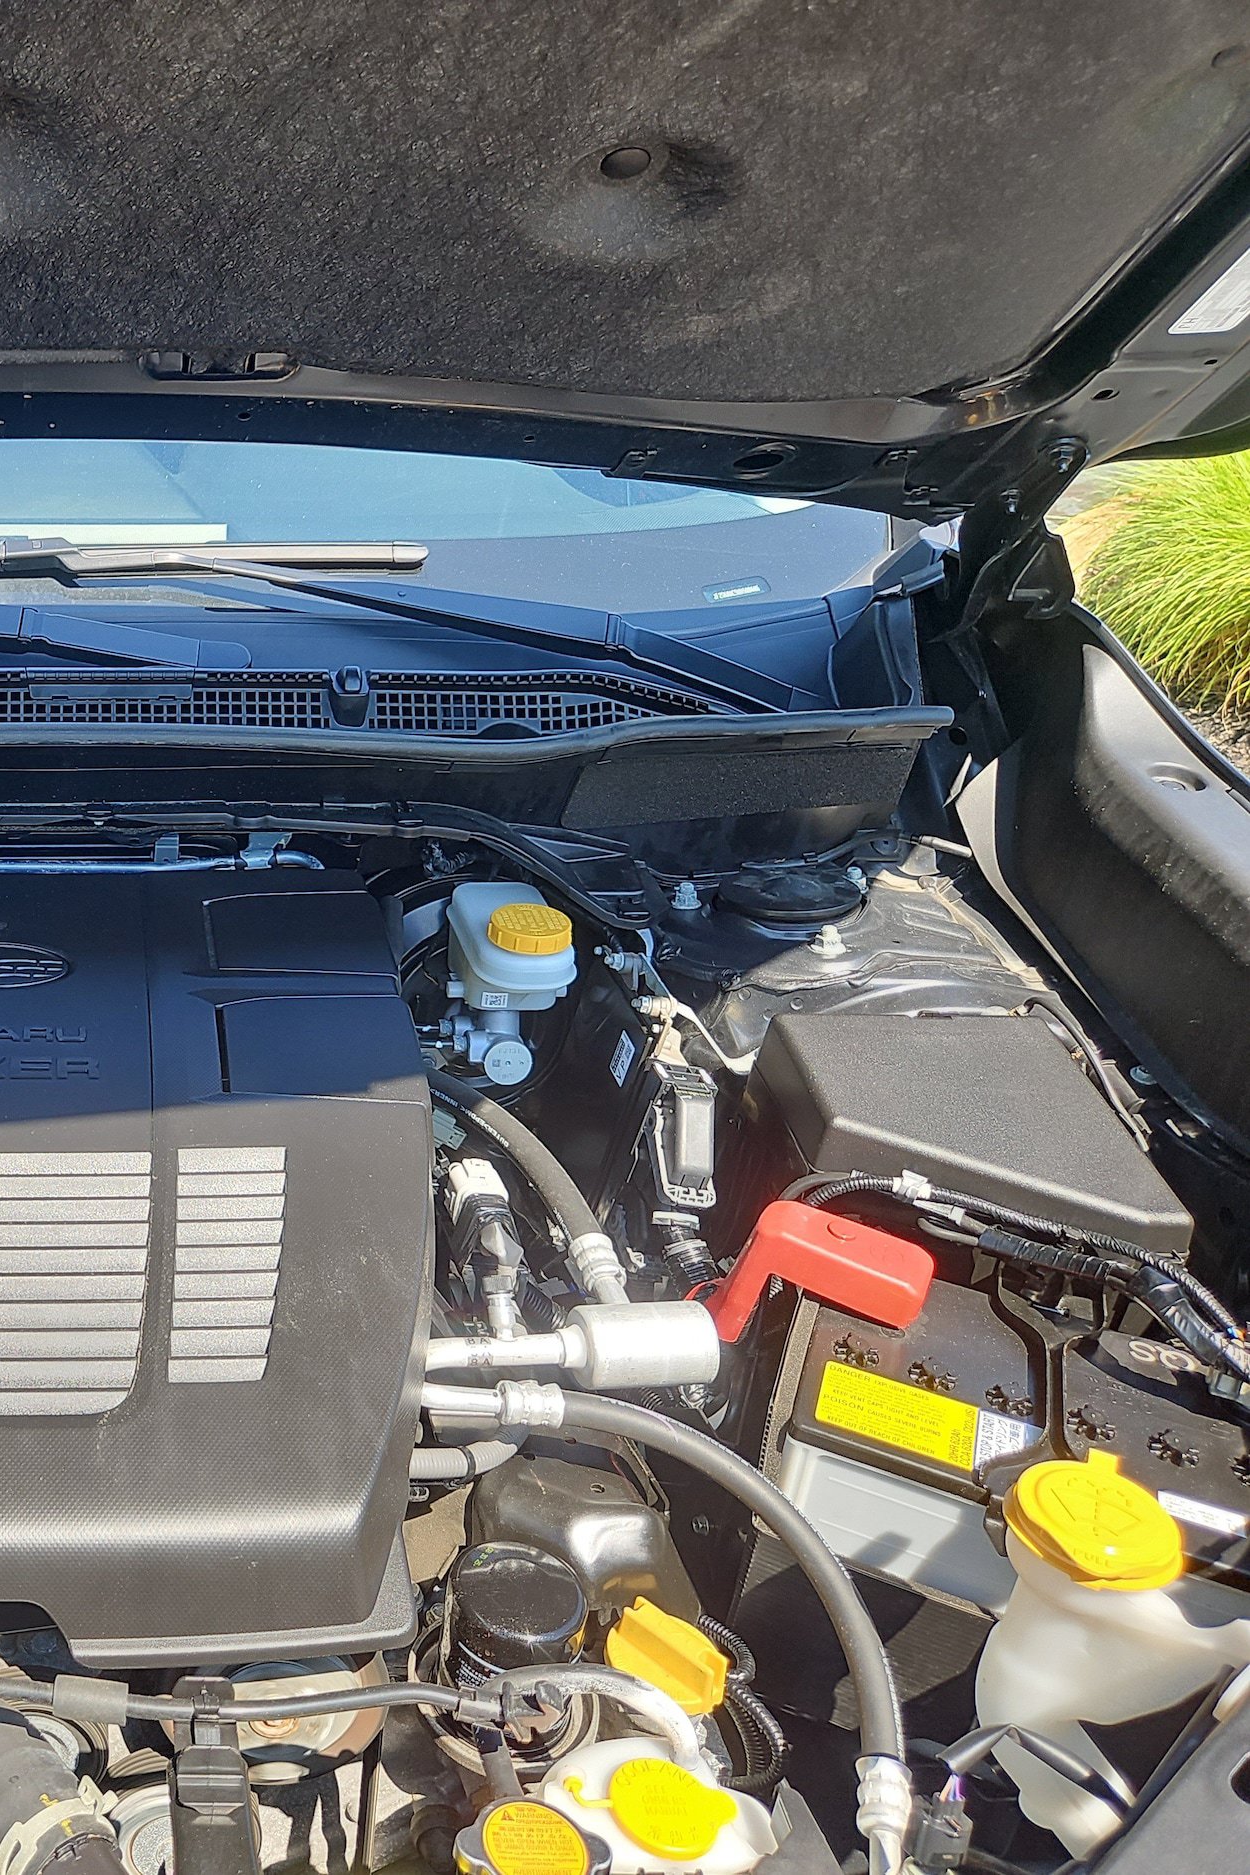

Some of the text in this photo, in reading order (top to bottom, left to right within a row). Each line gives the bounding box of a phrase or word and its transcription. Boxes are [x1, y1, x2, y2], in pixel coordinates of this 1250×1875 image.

[829, 1365, 871, 1383] DANGER
[823, 1394, 865, 1412] POISON
[982, 1414, 995, 1435] START
[979, 1440, 992, 1458] STOP
